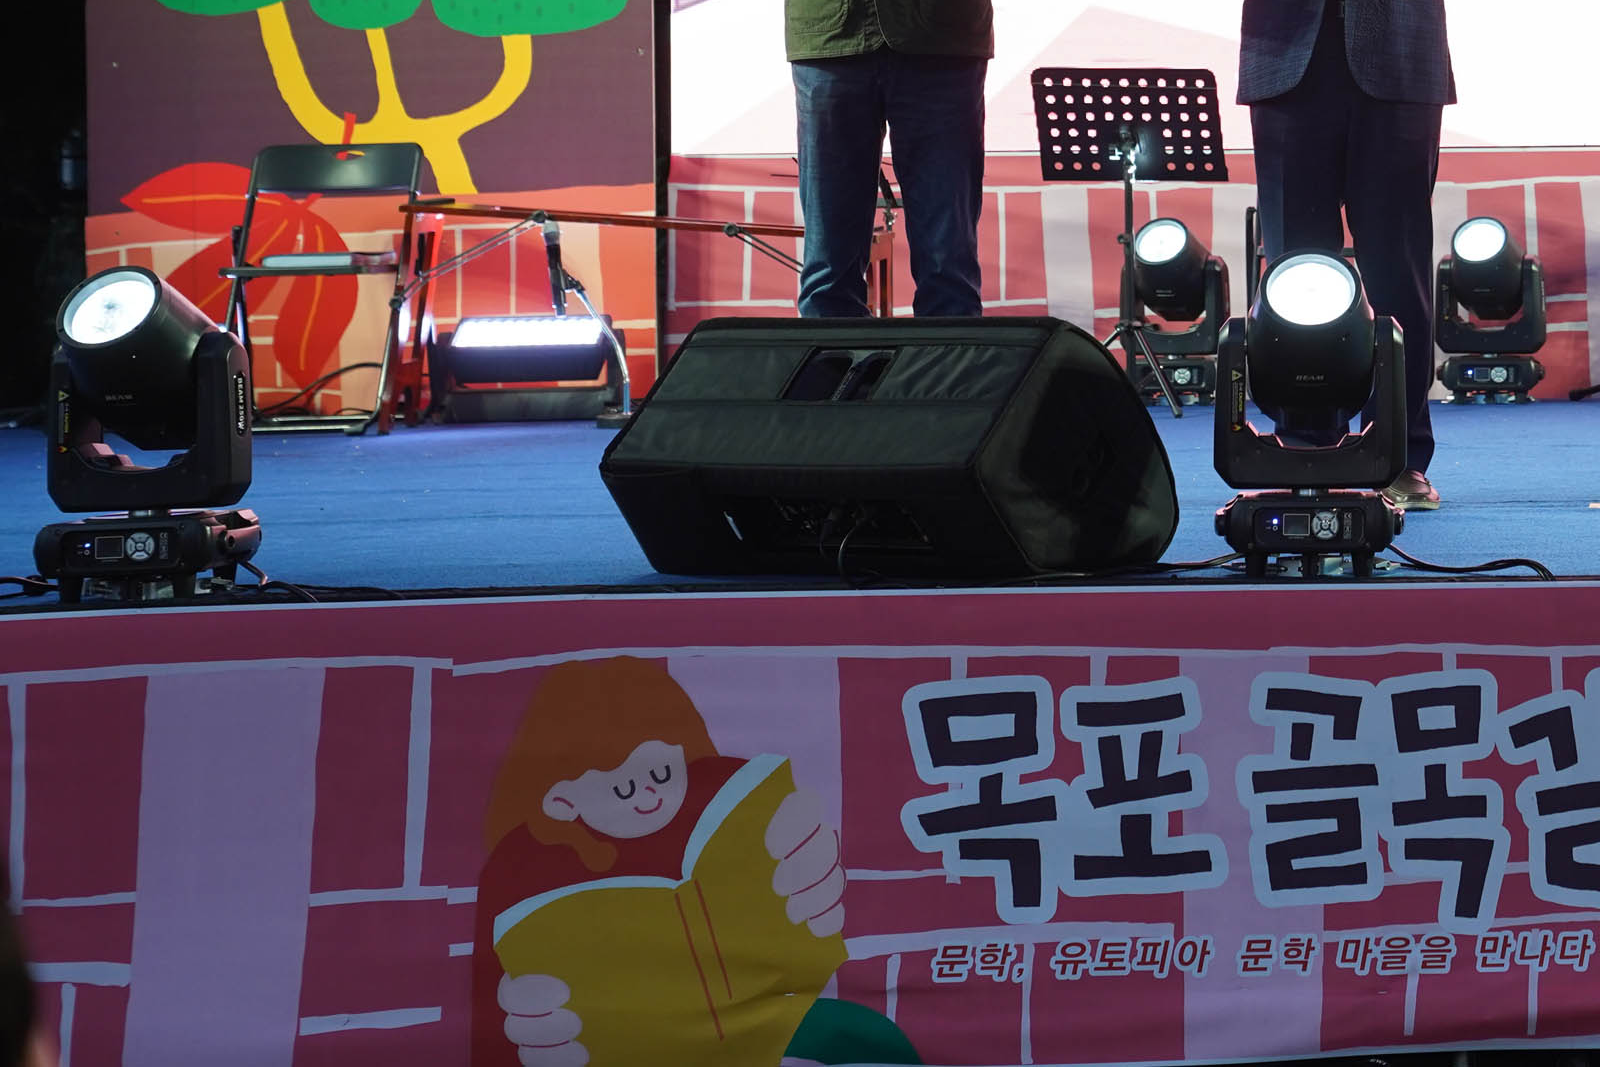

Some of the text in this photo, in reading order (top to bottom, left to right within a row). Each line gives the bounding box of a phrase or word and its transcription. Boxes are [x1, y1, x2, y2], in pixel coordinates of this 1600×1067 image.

[914, 687, 1213, 910] 목포
[933, 929, 1595, 979] 문학, 유토피아 문학 마을을 만나다
